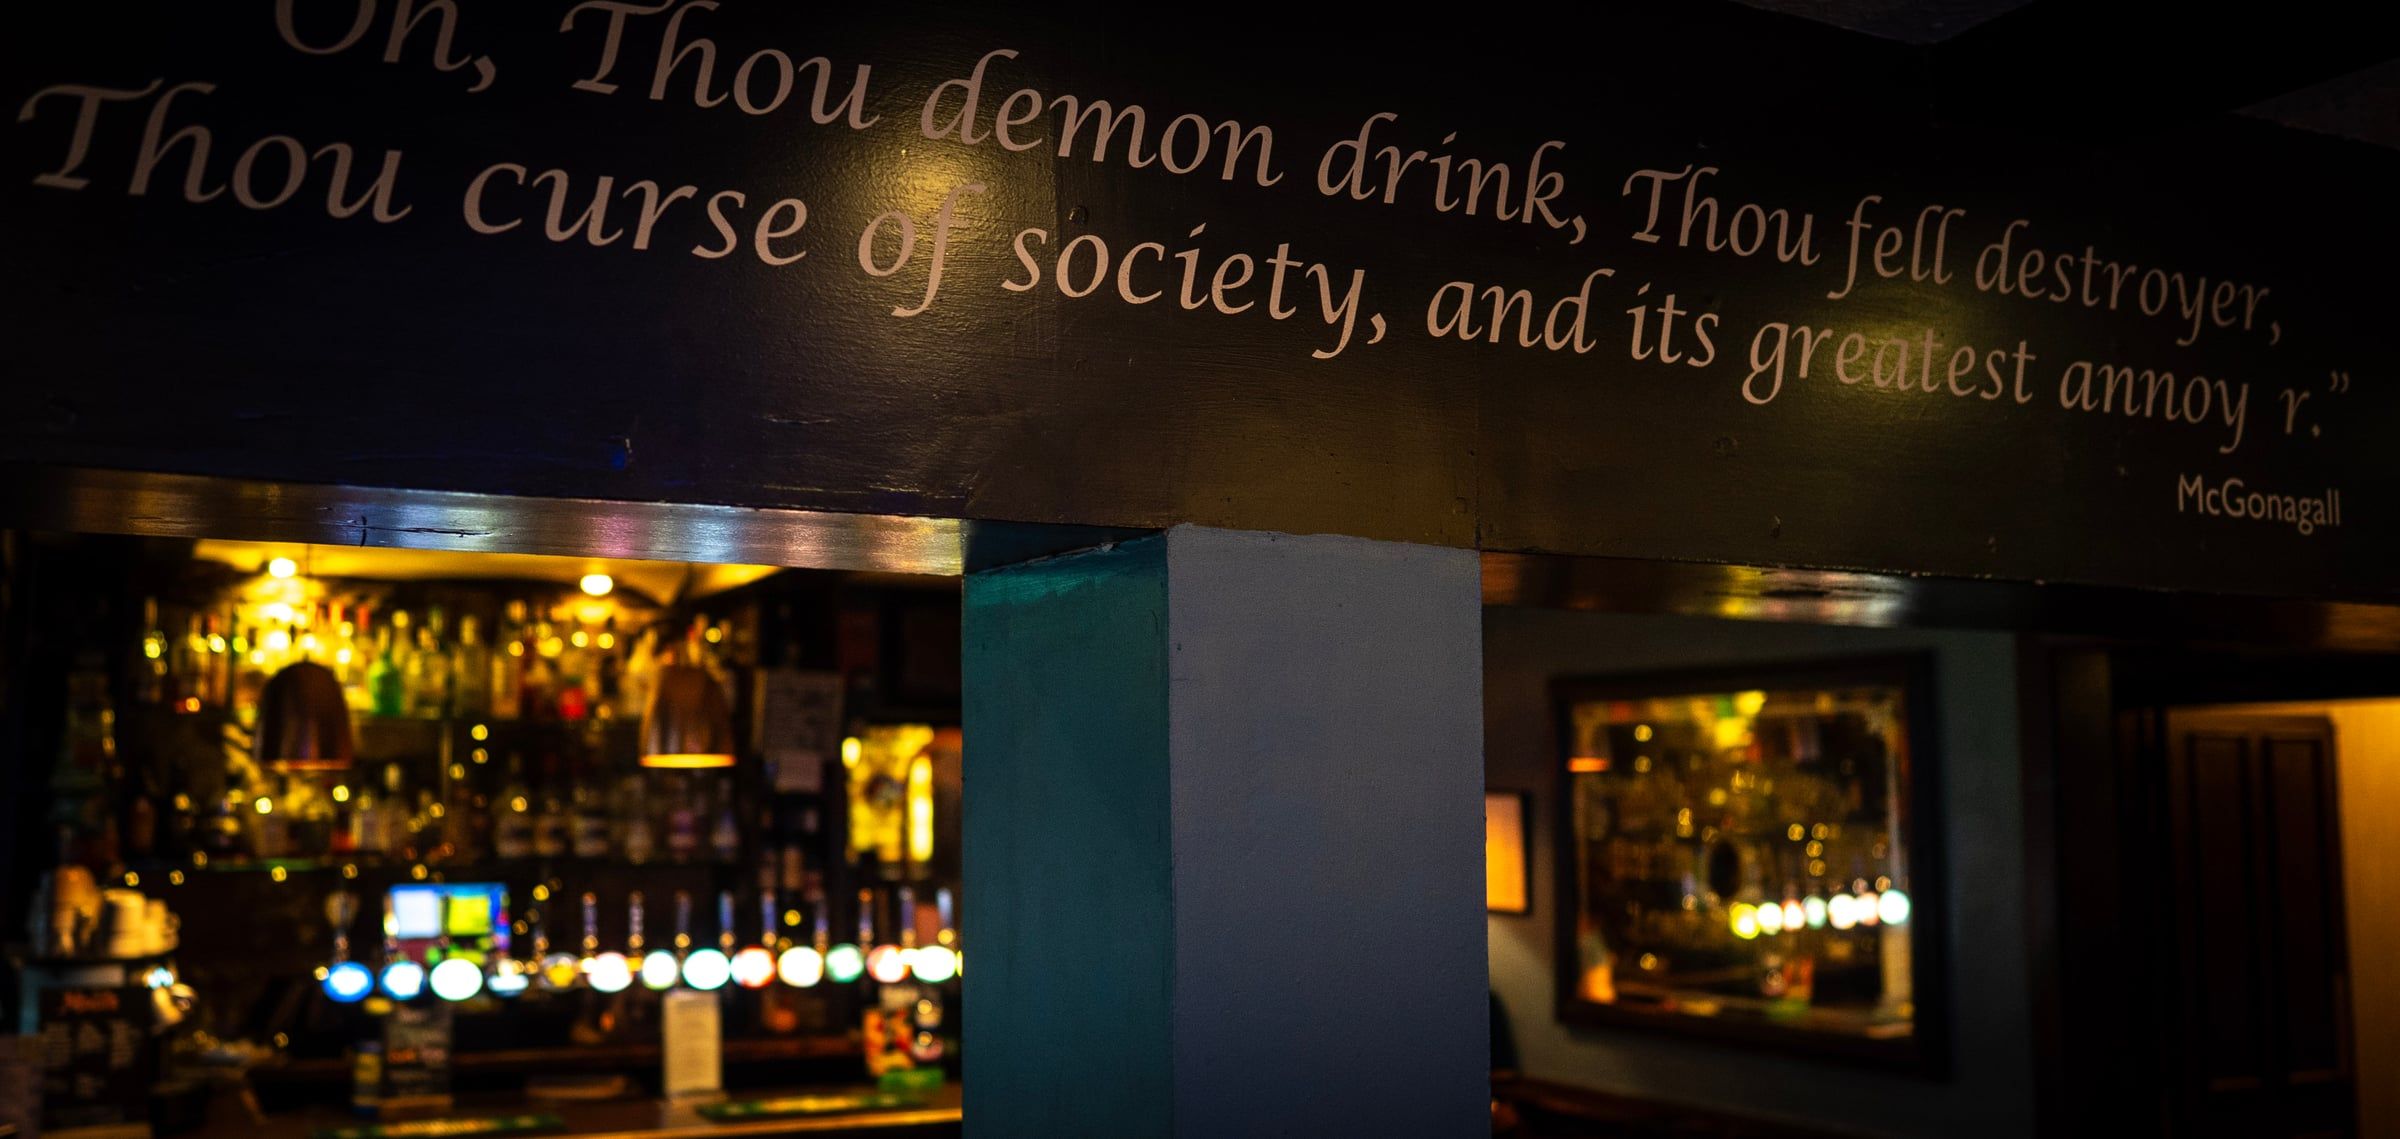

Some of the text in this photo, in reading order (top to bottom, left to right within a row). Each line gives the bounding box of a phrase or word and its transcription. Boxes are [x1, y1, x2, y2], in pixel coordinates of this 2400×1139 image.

[16, 77, 412, 225] Thou
[462, 161, 808, 267] curse
[857, 182, 988, 318] of
[1001, 223, 1387, 360] society,
[1426, 267, 1616, 354] and
[1626, 281, 1720, 369] its
[1741, 320, 2036, 406] greatest
[559, 0, 881, 130] Thou
[920, 48, 1284, 188] demon
[1317, 111, 1588, 246] drink,
[1622, 163, 1821, 267] Thou
[1827, 194, 1966, 300] fell
[1974, 219, 2283, 347] destroyer,
[2176, 473, 2343, 537] McGonagall
